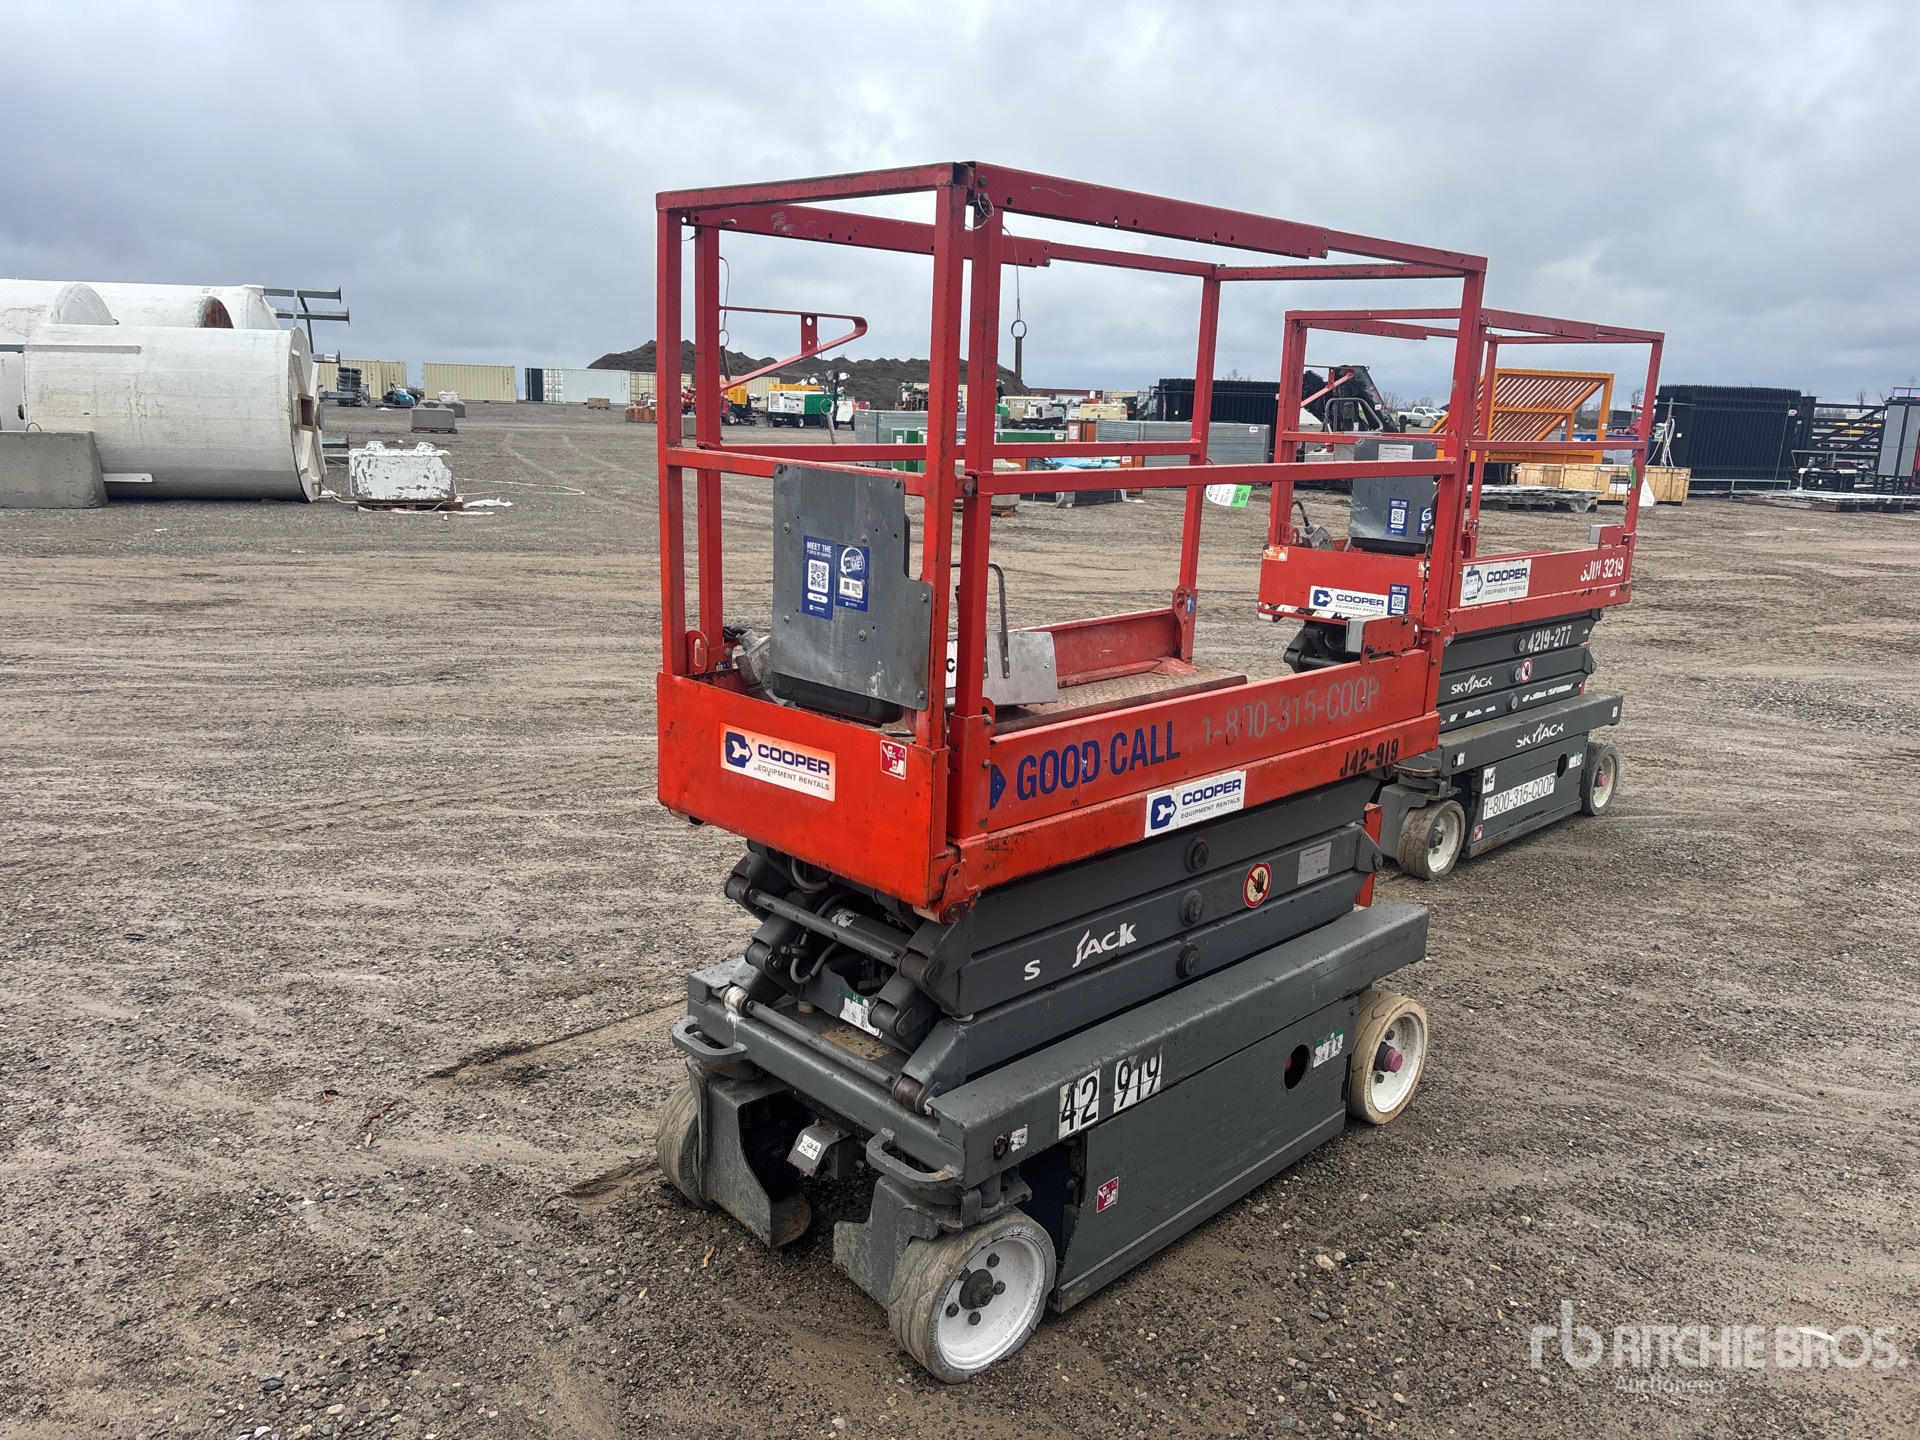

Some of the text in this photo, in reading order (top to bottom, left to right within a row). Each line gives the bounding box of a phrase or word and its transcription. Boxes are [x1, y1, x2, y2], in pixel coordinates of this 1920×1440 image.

[806, 541, 832, 554] MEET THE
[1486, 567, 1528, 583] COOPER
[1602, 557, 1624, 579] 3219
[1336, 593, 1384, 607] COOPER
[1485, 587, 1508, 596] EQUIPMENT
[1528, 625, 1573, 653] 4219-277
[1450, 674, 1493, 694] SKYJACK
[1515, 723, 1564, 748] SKYJACK
[758, 743, 830, 776] COOPER
[1017, 721, 1181, 801] GOOD CALL
[1340, 738, 1399, 777] J42-919
[757, 764, 830, 791] EQUIPMENT RENTALS
[1182, 778, 1242, 806] COOPER
[1484, 775, 1556, 818] 1-800-315-COOP
[1181, 796, 1240, 819] EQUIPMENT RENTALS
[1061, 1053, 1161, 1131] 42 919
